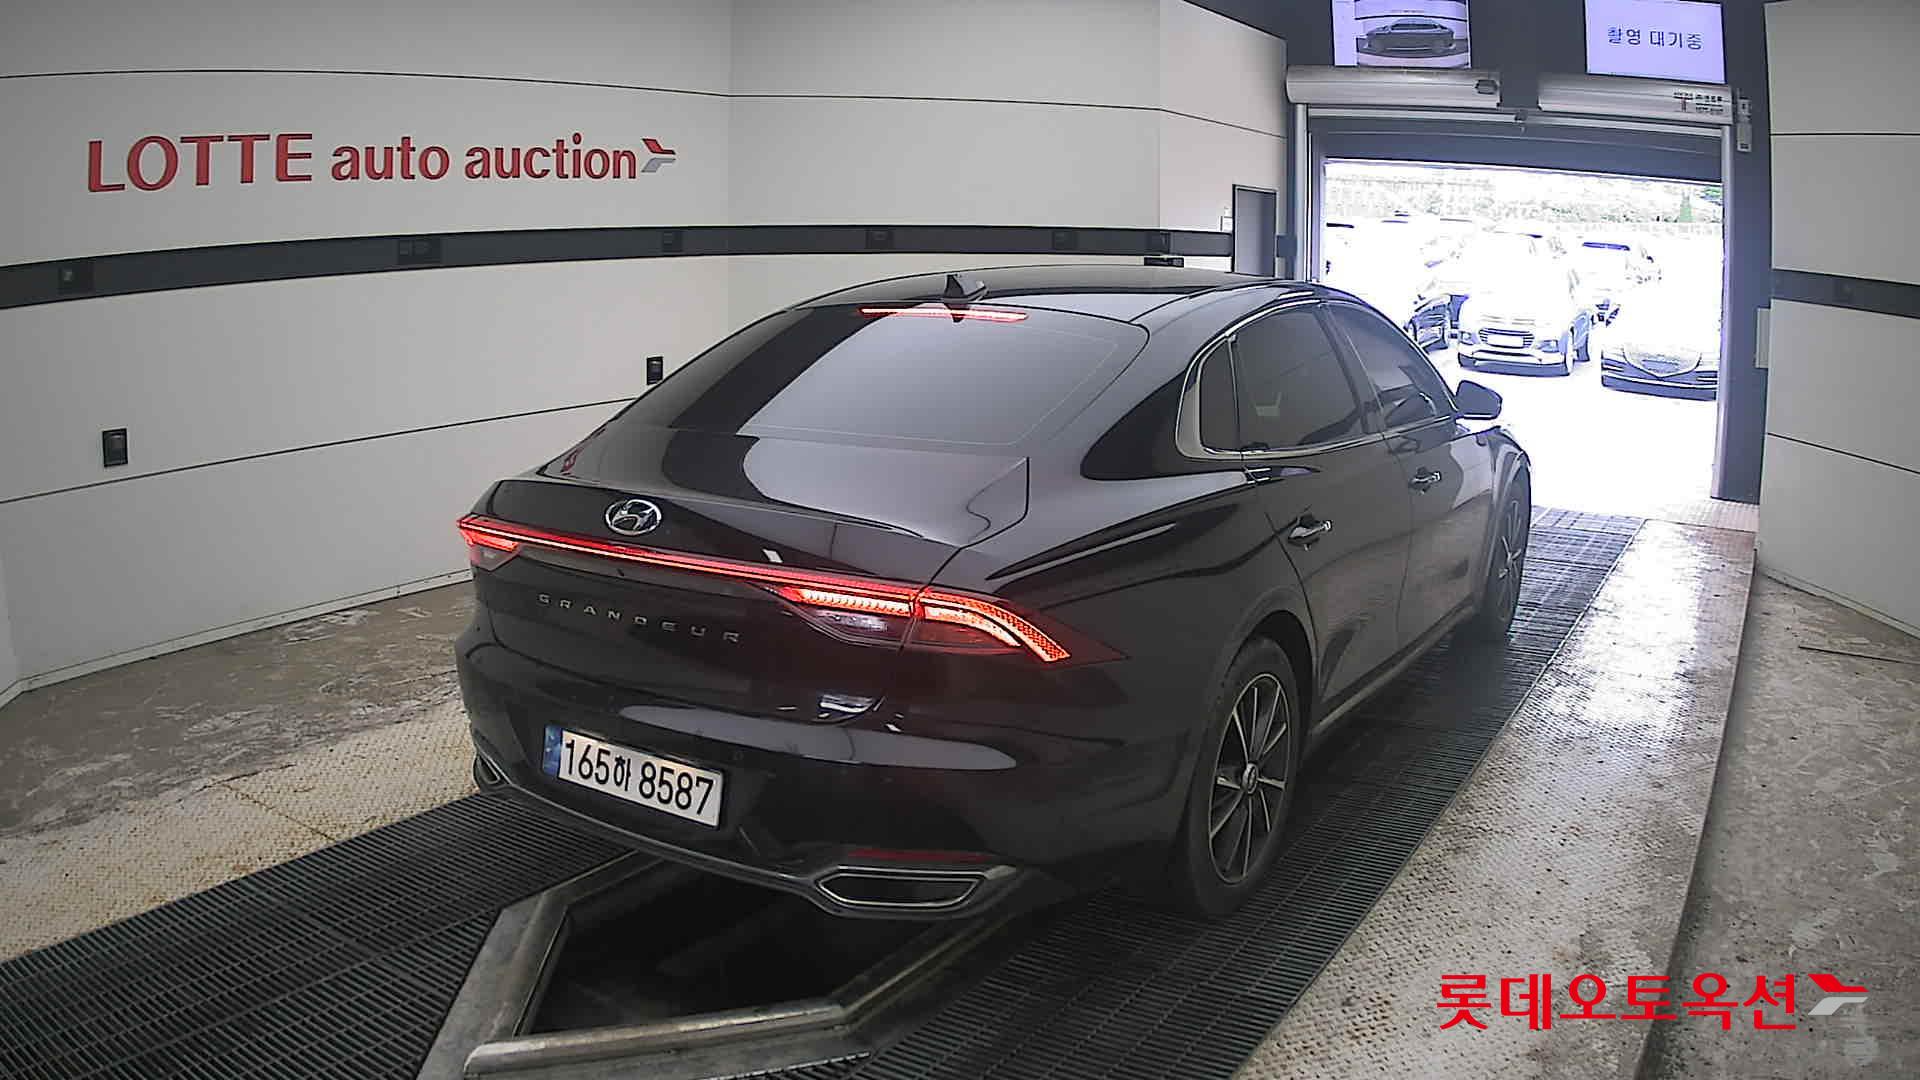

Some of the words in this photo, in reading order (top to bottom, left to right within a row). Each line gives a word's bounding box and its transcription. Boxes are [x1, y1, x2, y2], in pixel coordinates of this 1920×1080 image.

[1650, 31, 1702, 50] 대기중
[88, 133, 312, 192] LOTTE
[331, 135, 450, 180] auto
[465, 132, 637, 180] auction
[539, 593, 740, 643] GRANDEUR
[565, 739, 631, 792] 165하
[639, 761, 714, 815] 8587
